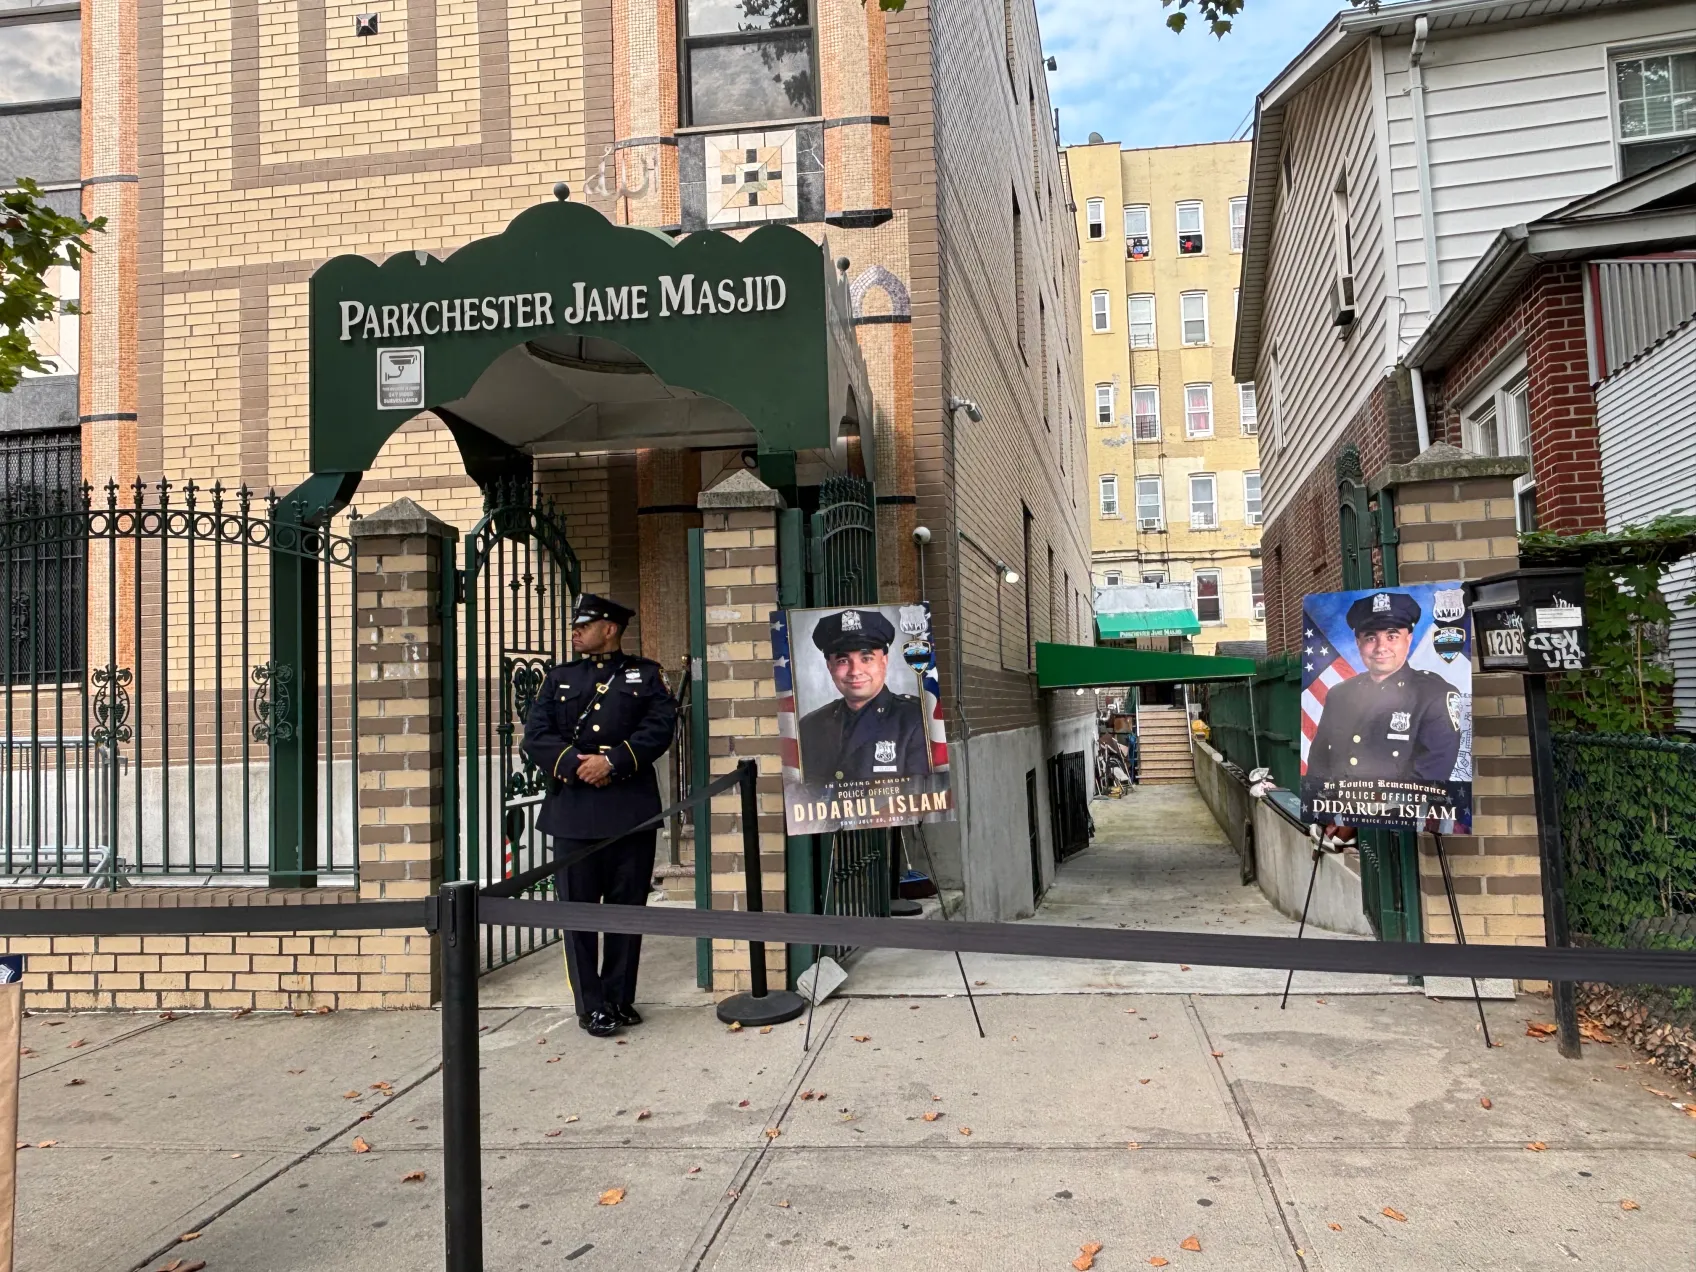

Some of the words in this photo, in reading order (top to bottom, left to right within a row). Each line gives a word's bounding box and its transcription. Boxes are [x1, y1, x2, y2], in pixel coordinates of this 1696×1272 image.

[339, 292, 554, 341] PARKCHESTER
[564, 282, 649, 325] JAME
[658, 273, 787, 317] MASJID
[1436, 608, 1461, 618] NYPD
[1488, 631, 1523, 655] 1203
[838, 780, 870, 788] LOVING
[874, 777, 911, 786] MEMORY
[1323, 781, 1336, 791] In
[1338, 779, 1374, 789] Loving
[1377, 779, 1447, 796] Remembrance
[838, 789, 865, 799] POLICE
[868, 786, 900, 797] OFFICER
[1338, 791, 1376, 800] POLICE
[1381, 792, 1428, 803] OFFICER
[794, 797, 880, 823] DIDARUL
[888, 791, 947, 814] ISLAM
[1313, 799, 1391, 817] DIDARUL
[1399, 803, 1457, 821] ISLAM
